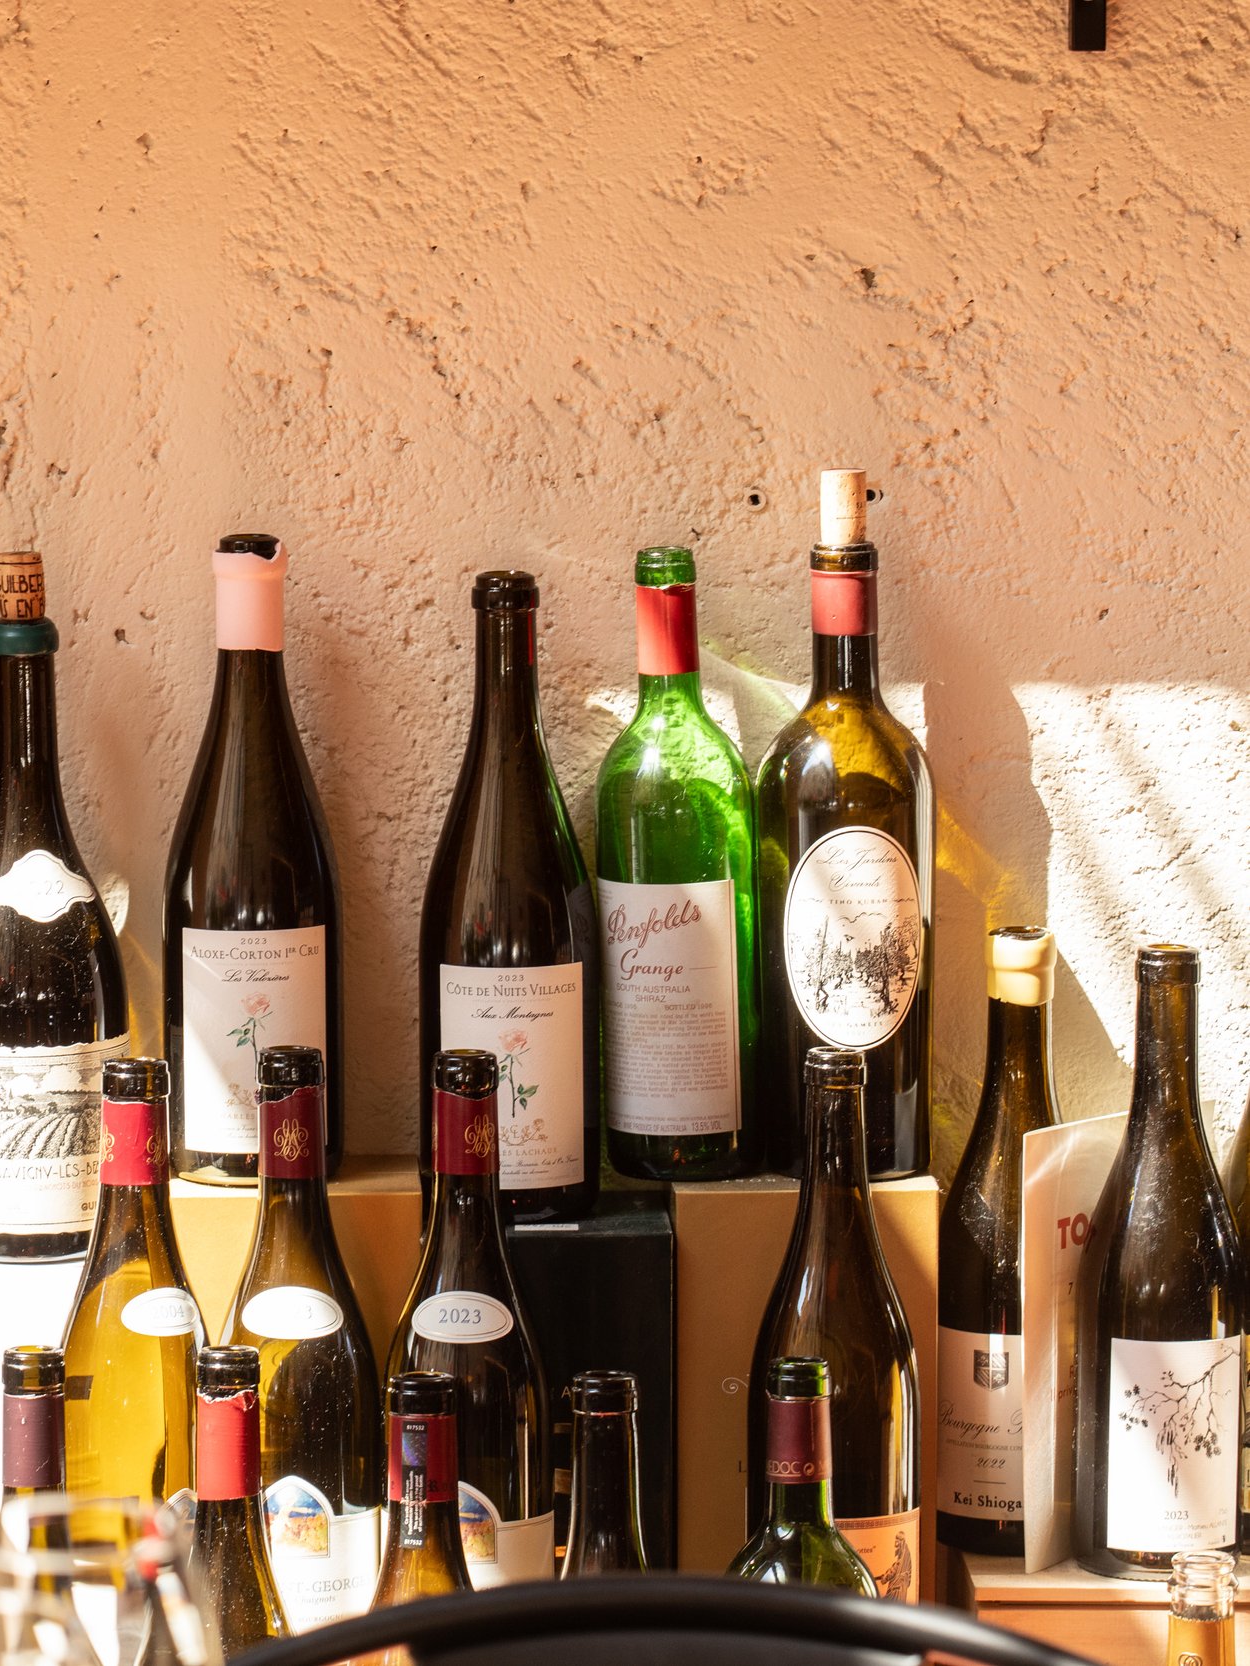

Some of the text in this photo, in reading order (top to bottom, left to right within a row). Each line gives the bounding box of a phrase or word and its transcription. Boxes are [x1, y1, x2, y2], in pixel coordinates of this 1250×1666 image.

[16, 598, 34, 618] EN
[607, 899, 703, 949] Penfolds
[240, 937, 268, 945] 2023
[189, 945, 282, 960] ALOXE-CORTON
[619, 948, 684, 983] Grange
[221, 968, 243, 983] Les
[497, 974, 525, 982] 2023
[446, 981, 577, 997] CÔTE DE NUITS VILLAGES
[616, 982, 692, 994] SOUTH AUSTRALIA
[635, 994, 667, 1004] SHIRAZ
[471, 1005, 555, 1022] Aux Montagnes
[437, 1306, 483, 1327] 2023
[938, 1400, 1001, 1440] Bourgogne
[975, 1457, 1007, 1470] 2022
[953, 1491, 1023, 1513] Kei Shioga
[1163, 1510, 1190, 1520] 2023
